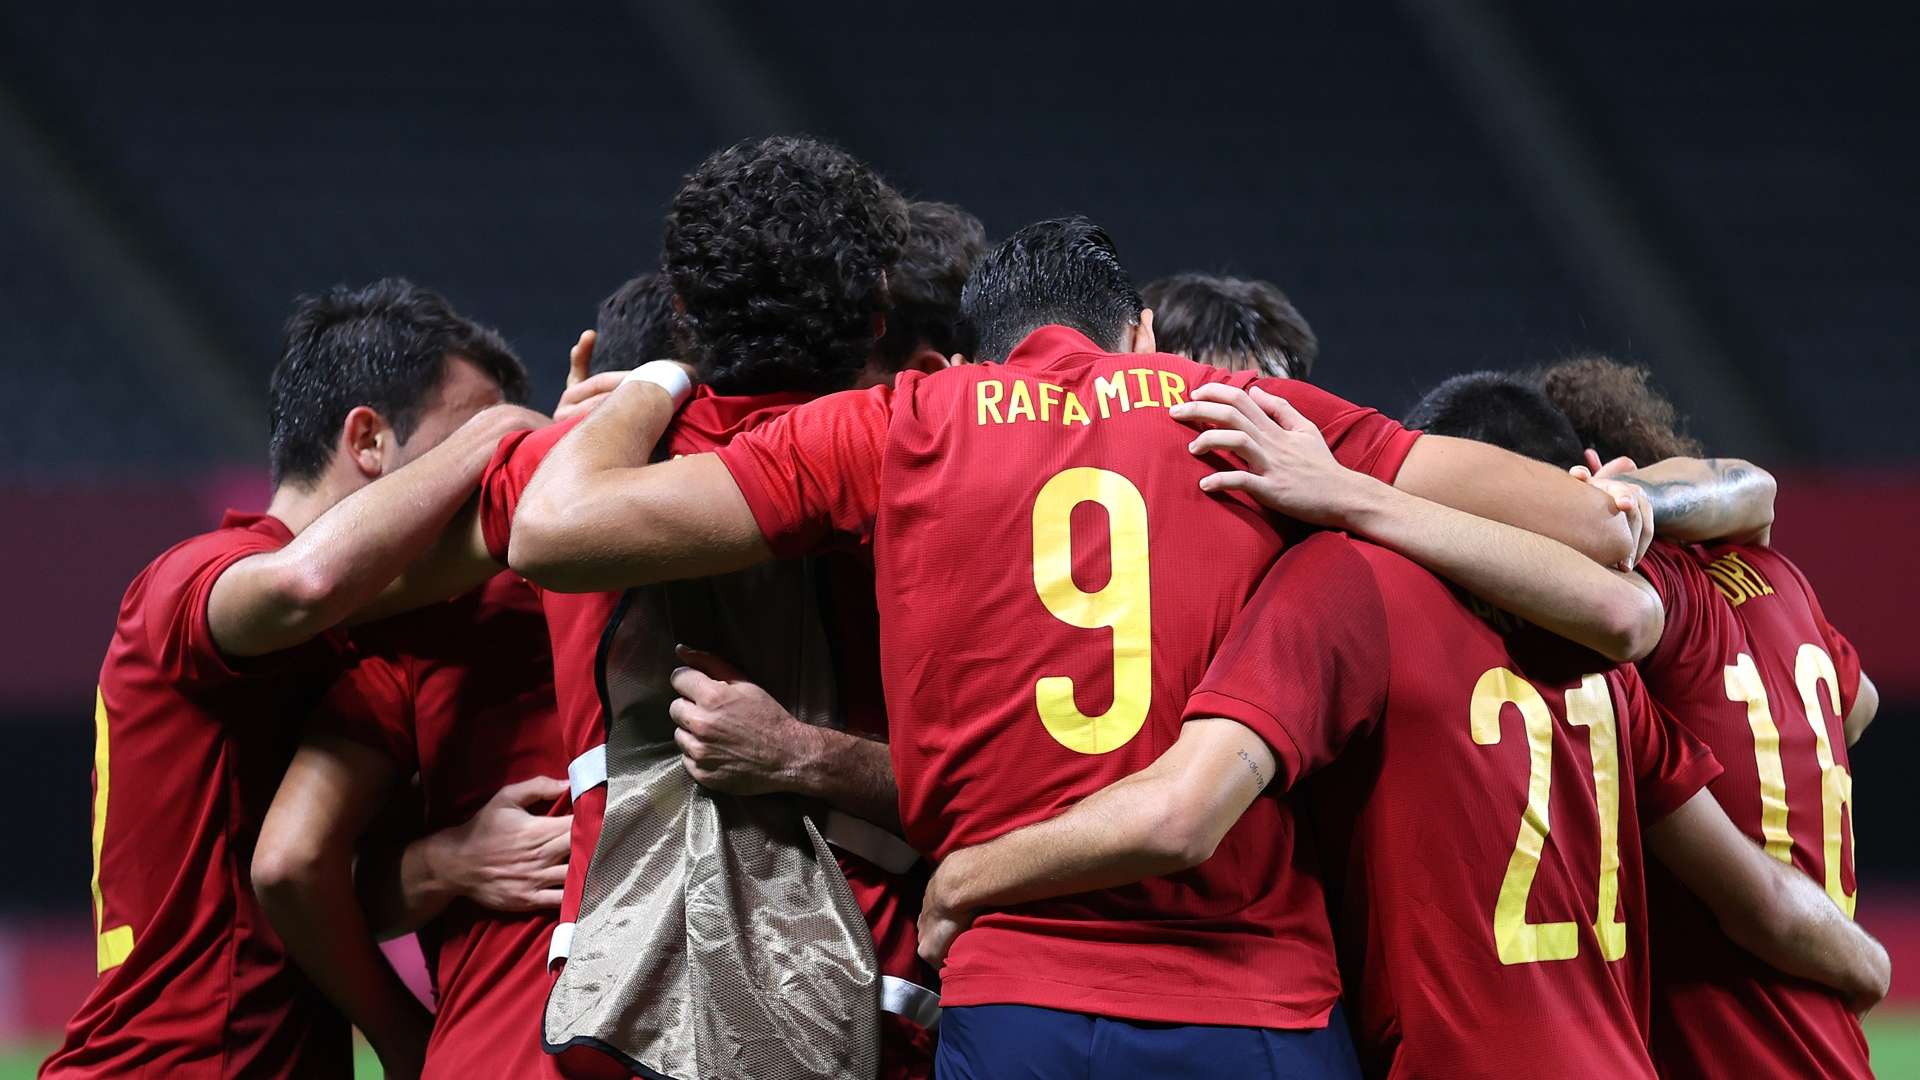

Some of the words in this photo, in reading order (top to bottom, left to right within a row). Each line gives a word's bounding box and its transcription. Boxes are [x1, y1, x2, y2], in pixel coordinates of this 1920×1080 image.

[976, 379, 1091, 426] RAFA
[1093, 368, 1187, 420] MIR
[1031, 466, 1152, 755] 9
[1470, 667, 1627, 965] 21
[1723, 643, 1857, 921] 16
